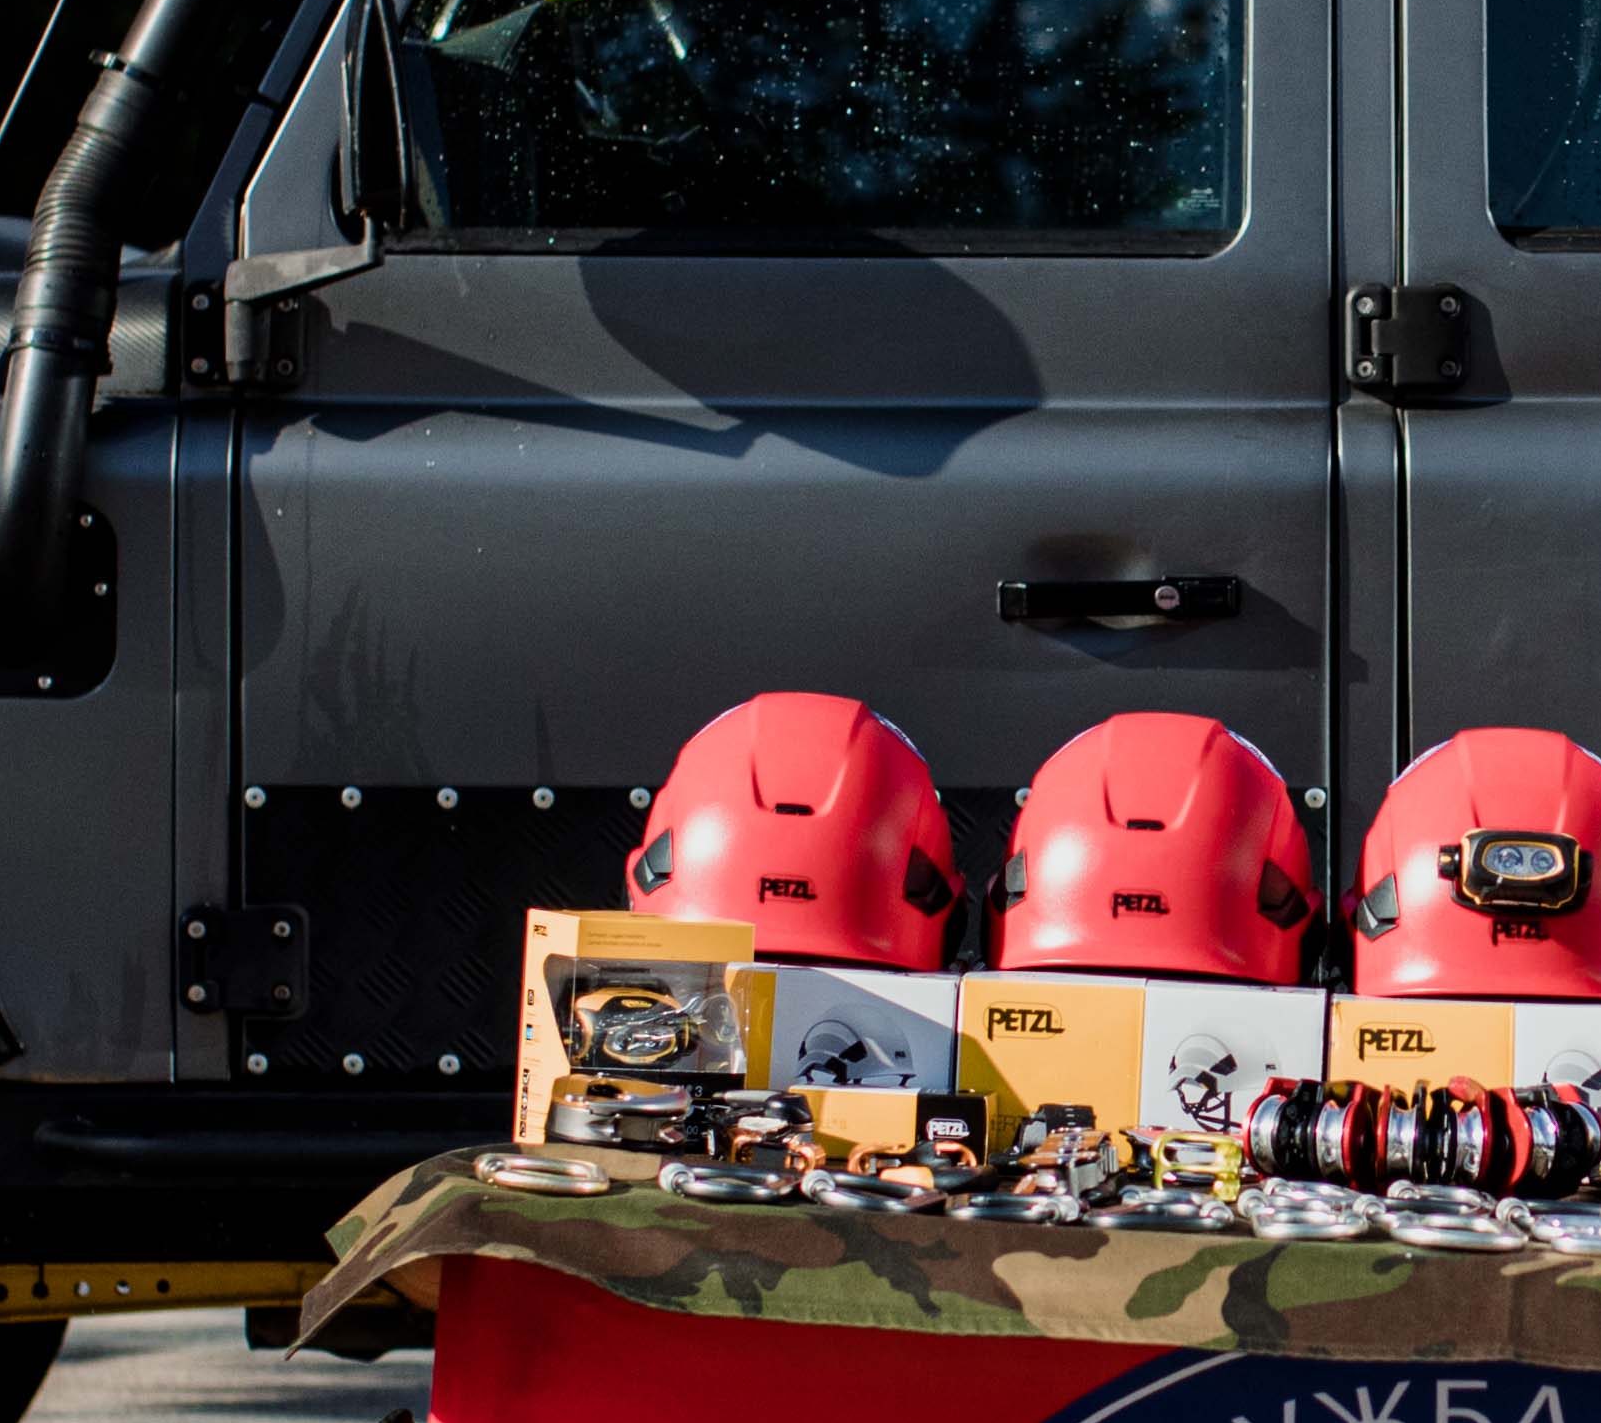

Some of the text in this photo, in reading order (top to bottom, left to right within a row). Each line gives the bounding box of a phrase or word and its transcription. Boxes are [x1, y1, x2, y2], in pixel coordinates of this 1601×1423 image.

[759, 877, 817, 904] PETZL
[1112, 892, 1170, 919] PETZL
[1491, 919, 1550, 947] PETZL
[987, 1007, 1065, 1041] PETZL
[1359, 1028, 1436, 1062] PETZL
[928, 1119, 970, 1141] PETZL
